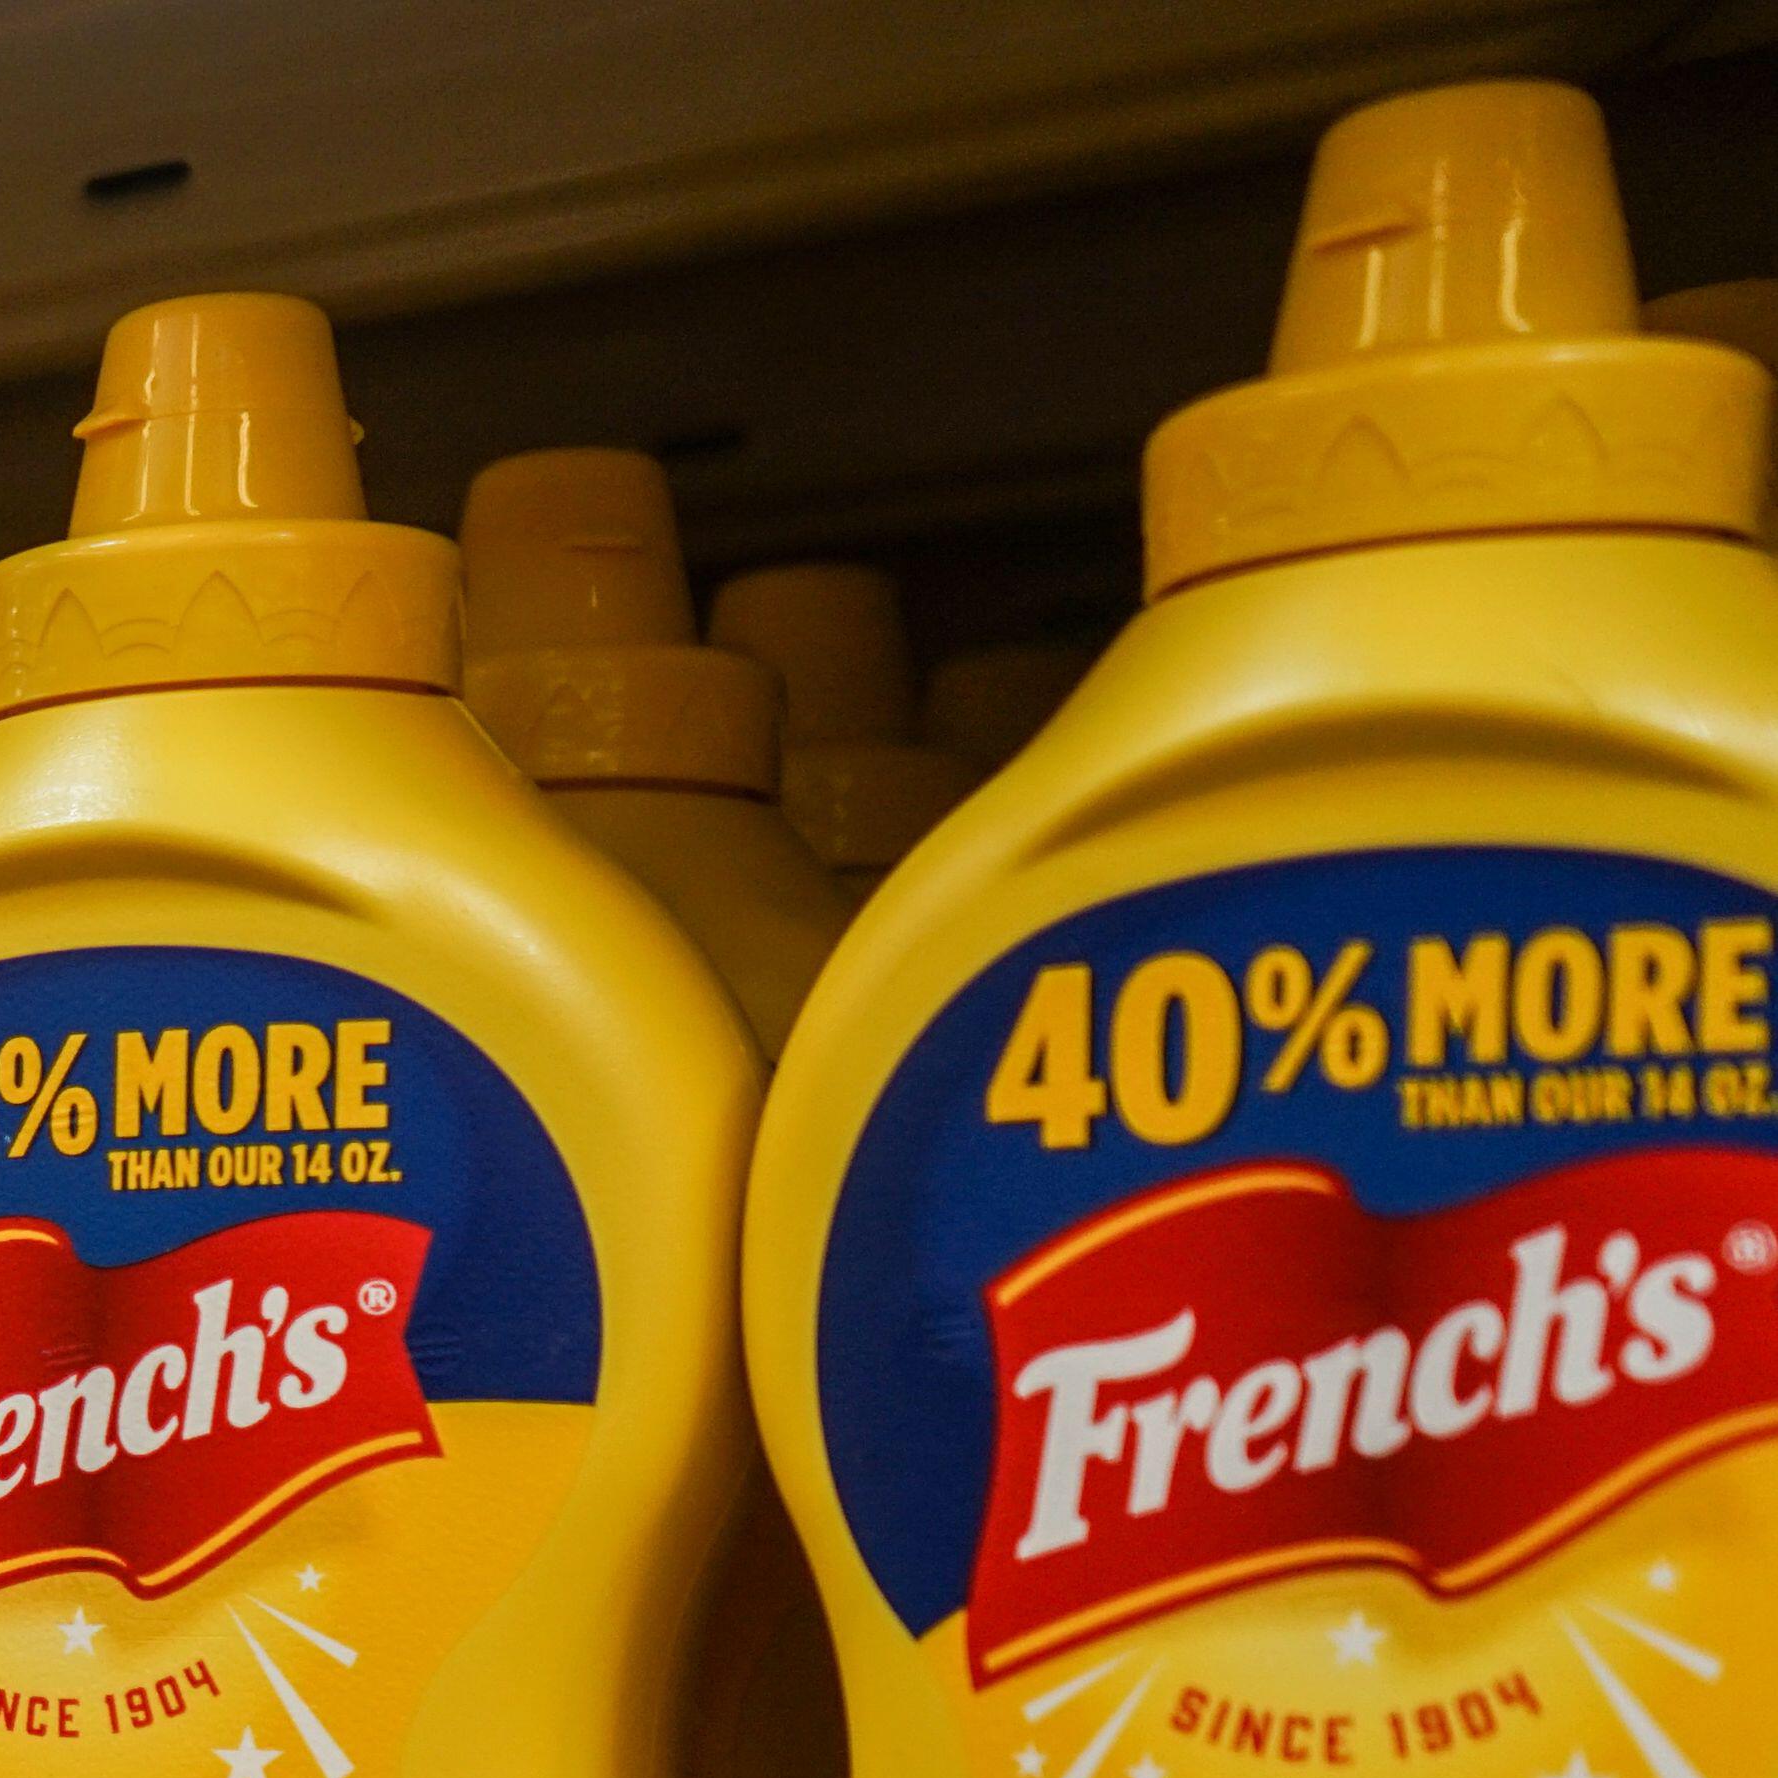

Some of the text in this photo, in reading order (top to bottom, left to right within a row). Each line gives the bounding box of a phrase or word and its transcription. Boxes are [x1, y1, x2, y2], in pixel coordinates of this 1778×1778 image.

[985, 913, 1775, 1150] 40% MORE
[113, 1018, 392, 1139] MORE
[1399, 1073, 1525, 1131] THAN
[108, 1140, 403, 1192] THAN OUR 14 OZ.
[105, 1658, 223, 1736] 1904
[1168, 1670, 1544, 1767] SINCE 1904
